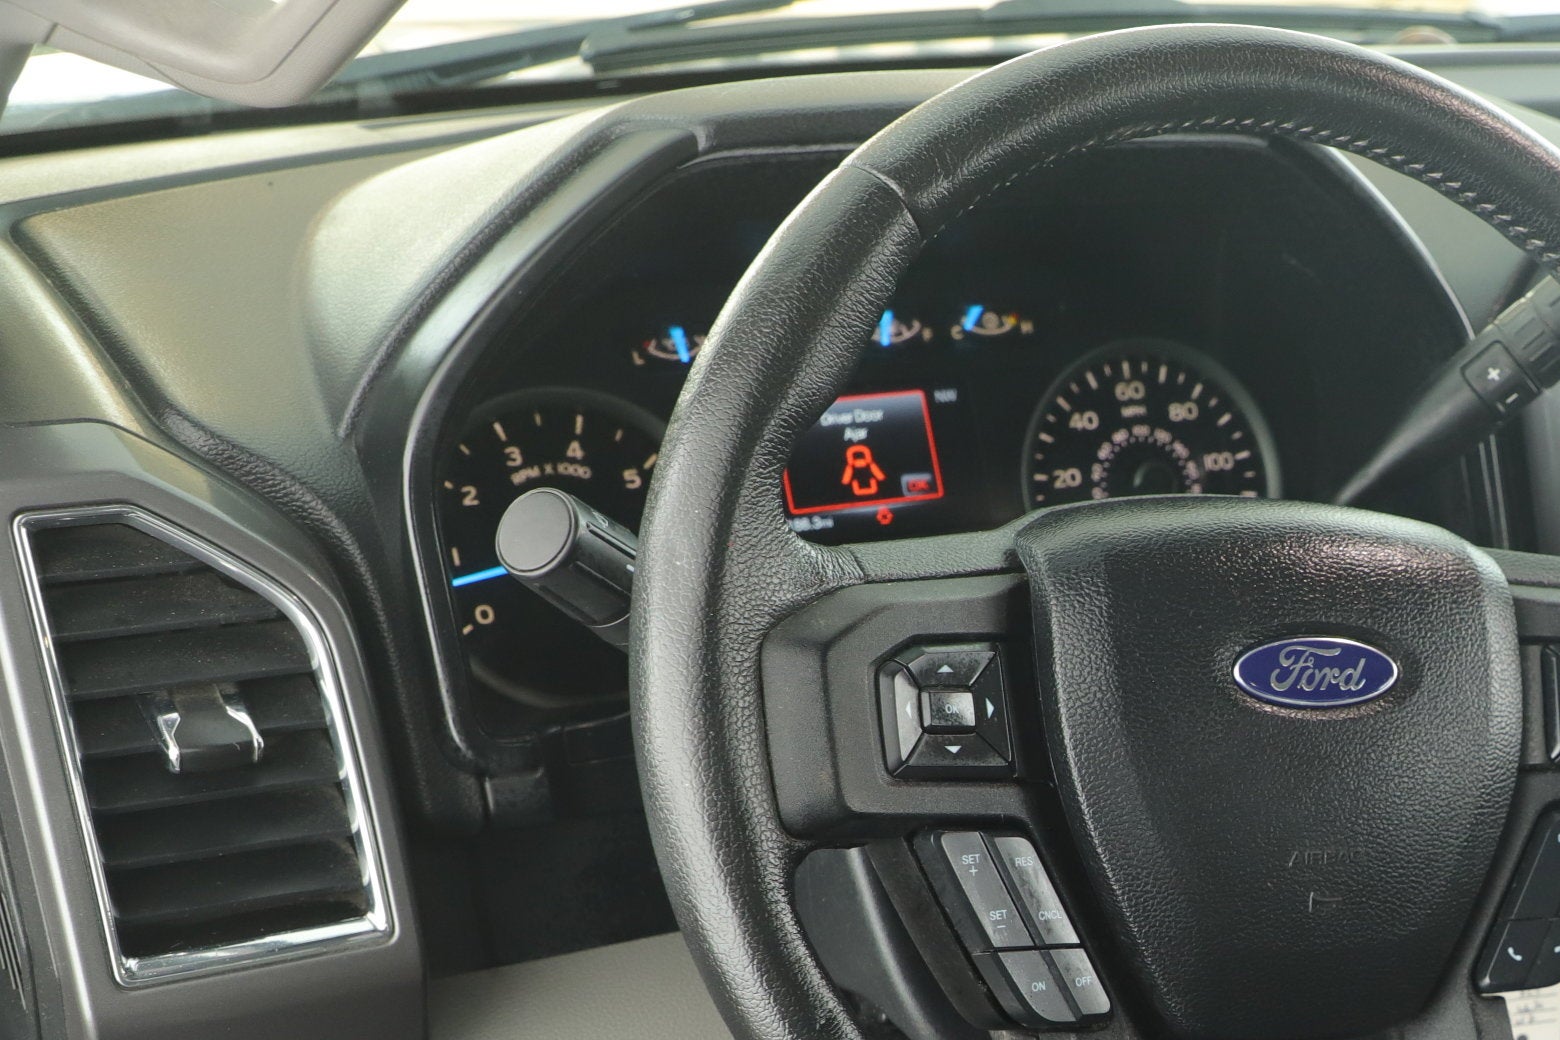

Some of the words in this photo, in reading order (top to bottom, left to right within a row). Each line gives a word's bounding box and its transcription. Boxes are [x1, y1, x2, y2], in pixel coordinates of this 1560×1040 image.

[1115, 380, 1145, 401] 60
[853, 408, 884, 423] Door
[1069, 410, 1100, 431] 40
[1168, 401, 1199, 422] 80
[504, 446, 523, 467] 3
[566, 440, 584, 460] 4
[1203, 451, 1235, 472] 100
[510, 465, 540, 486] RPM
[556, 462, 592, 479] 1000
[622, 468, 642, 489] 5
[1053, 467, 1082, 489] 20
[460, 486, 480, 506] 2
[474, 604, 495, 625] 0
[1270, 645, 1366, 691] Ford
[945, 704, 959, 714] OK
[961, 853, 980, 865] SET
[1015, 856, 1034, 867] RES
[989, 909, 1007, 921] SET
[1038, 910, 1063, 921] CNCL
[1031, 981, 1046, 992] ON
[1075, 976, 1093, 988] OFF
